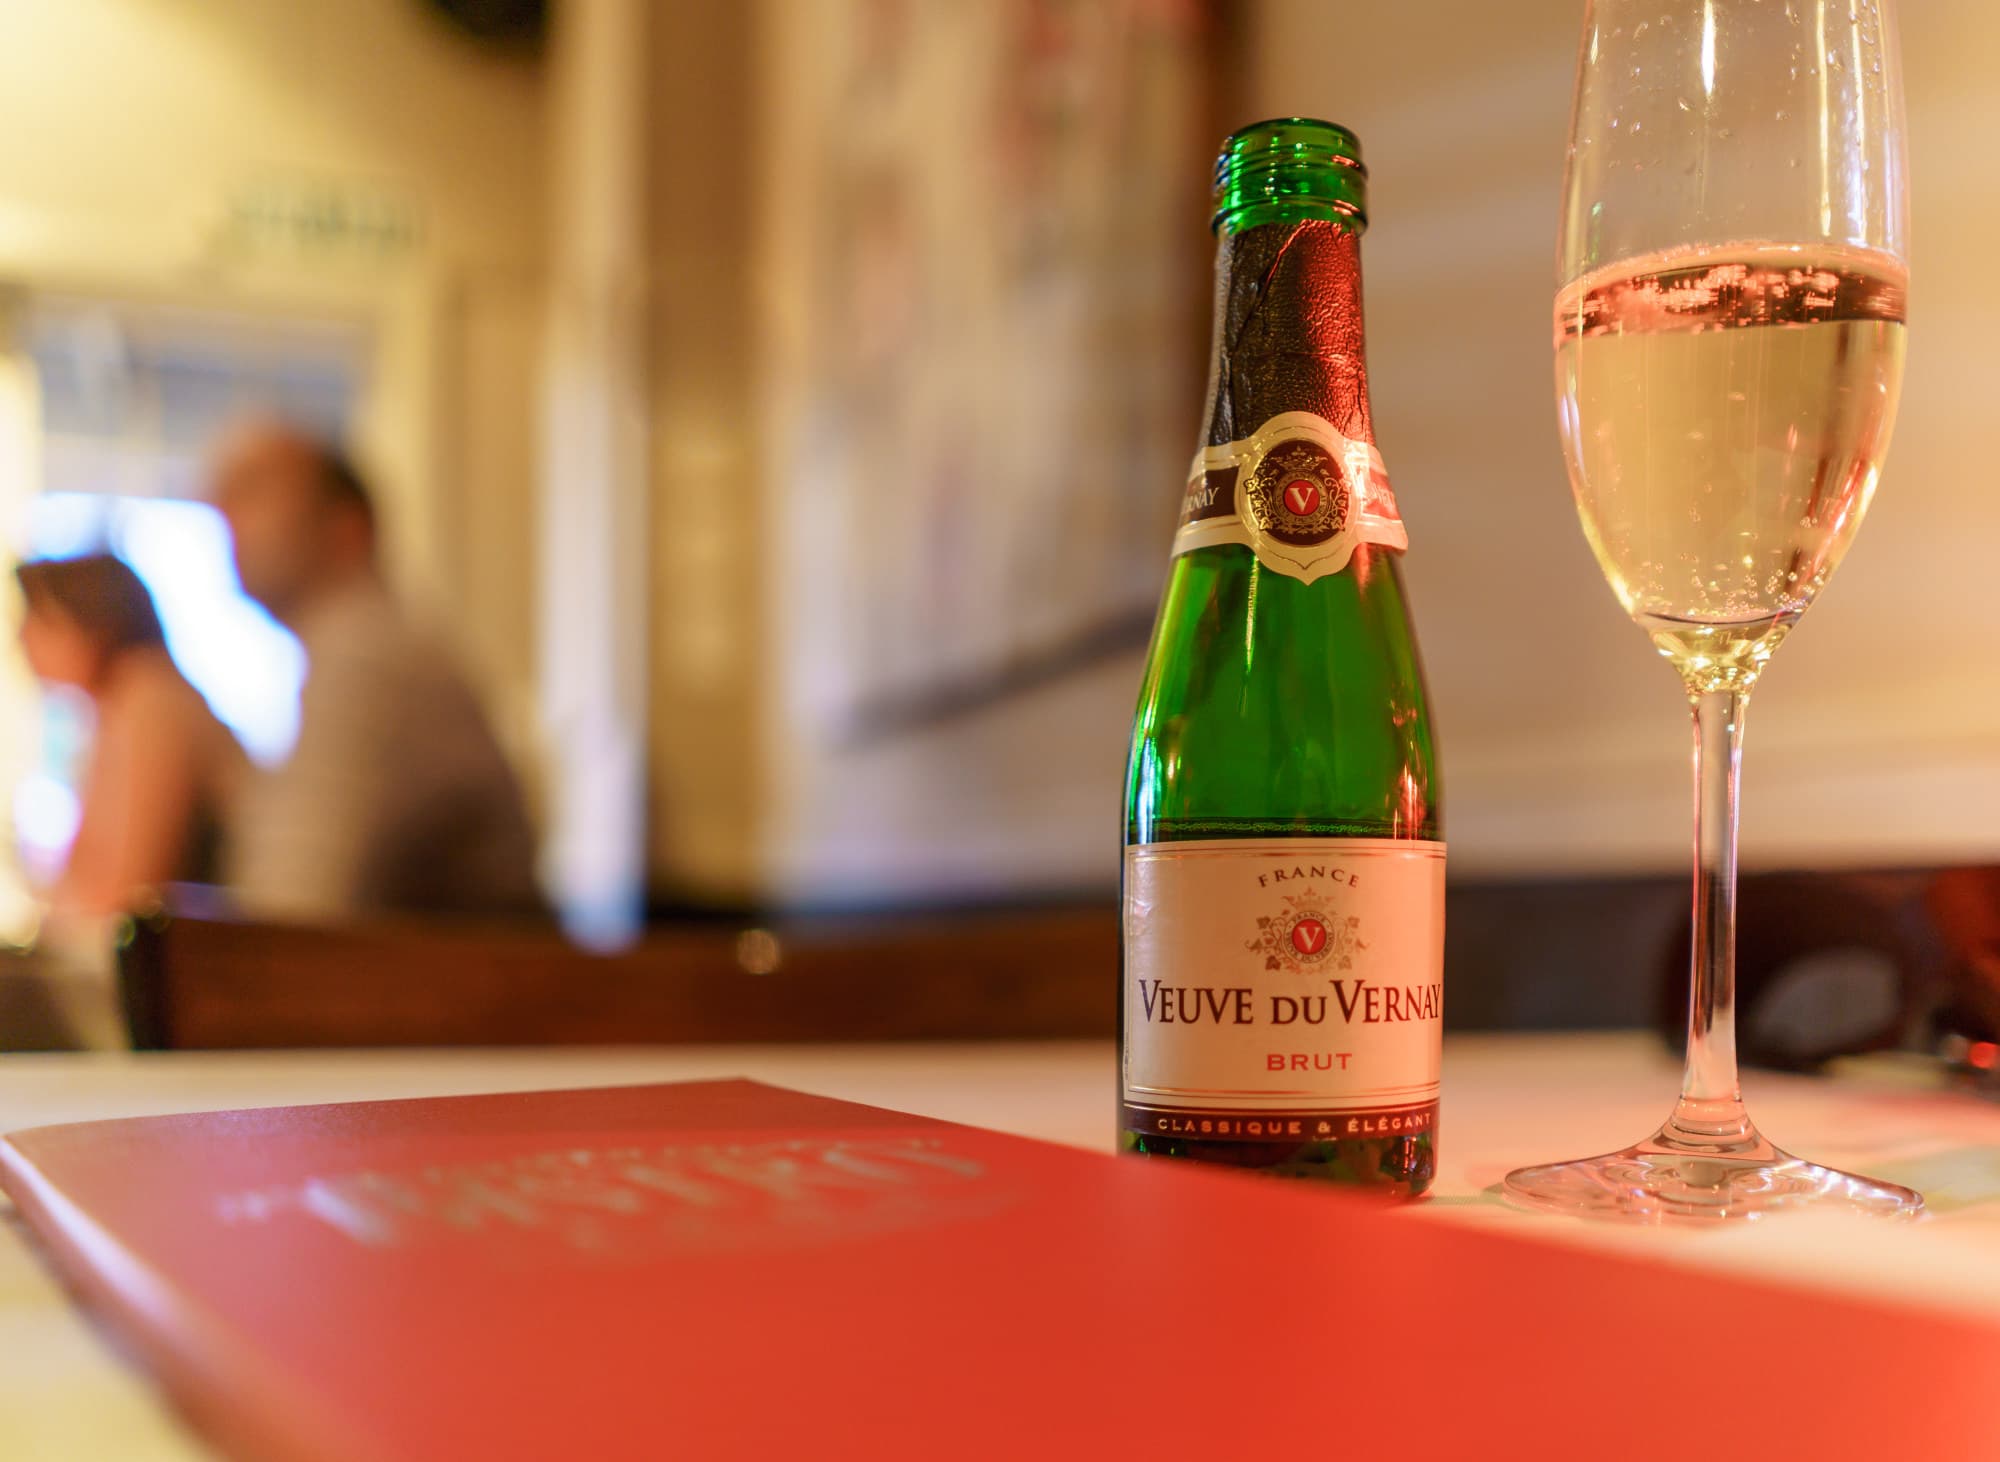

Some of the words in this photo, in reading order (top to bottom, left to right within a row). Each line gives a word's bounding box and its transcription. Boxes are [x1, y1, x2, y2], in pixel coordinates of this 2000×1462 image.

[1289, 487, 1314, 512] V
[1258, 865, 1359, 888] FRANCE
[1298, 926, 1321, 951] V
[1138, 979, 1254, 1025] VEUVE
[1269, 996, 1328, 1025] DU
[1329, 979, 1441, 1025] VERNAY
[1266, 1053, 1352, 1072] BRUT
[1157, 1118, 1302, 1135] CLASSIQUE
[1317, 1121, 1332, 1134] &
[1347, 1112, 1432, 1133] ÉLÉGANT
